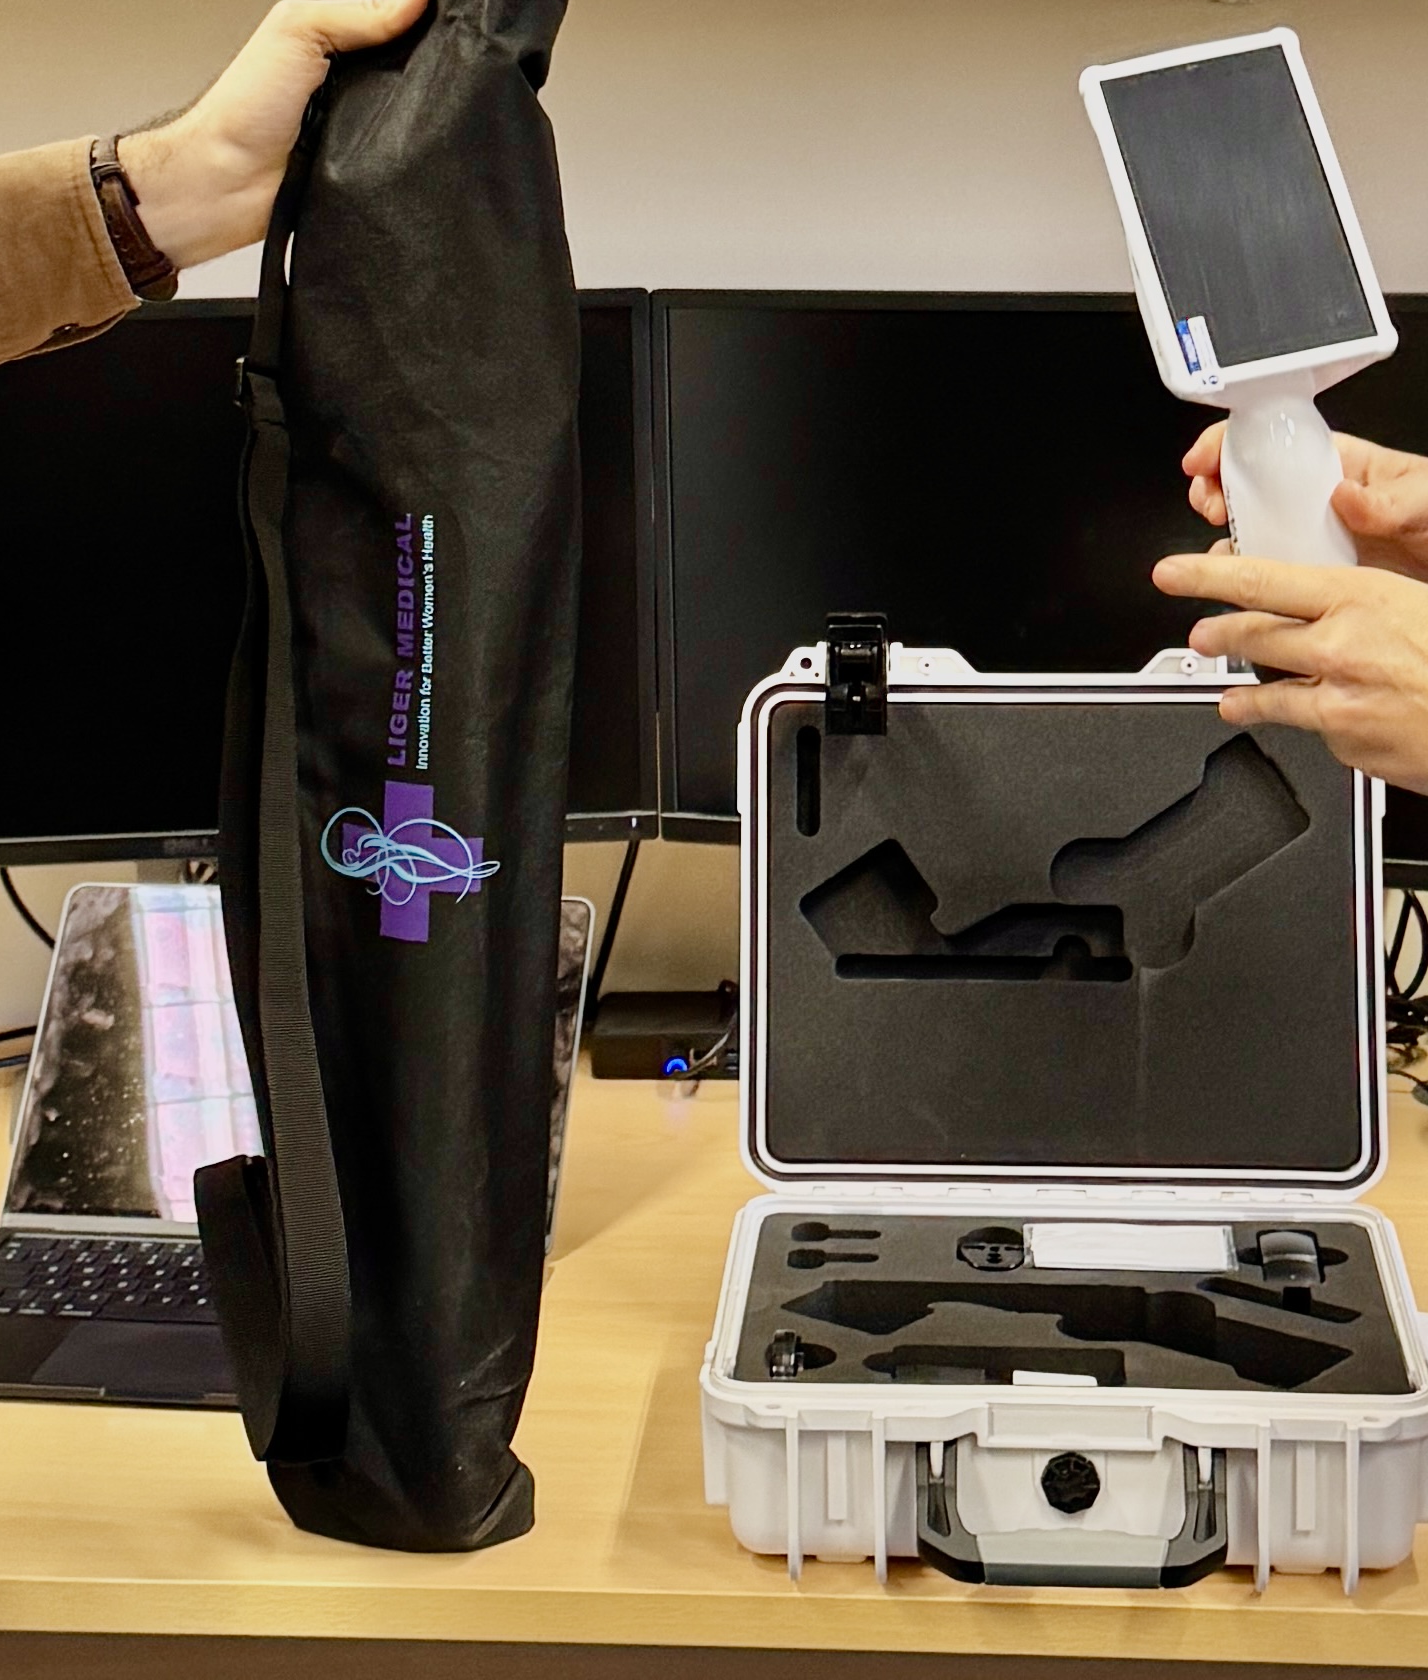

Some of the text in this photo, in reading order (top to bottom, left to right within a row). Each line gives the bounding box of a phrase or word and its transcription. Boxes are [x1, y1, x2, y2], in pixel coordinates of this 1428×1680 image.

[387, 513, 415, 766] LIGER MEDICAL
[416, 515, 435, 770] Innovation for Better Women's Health
